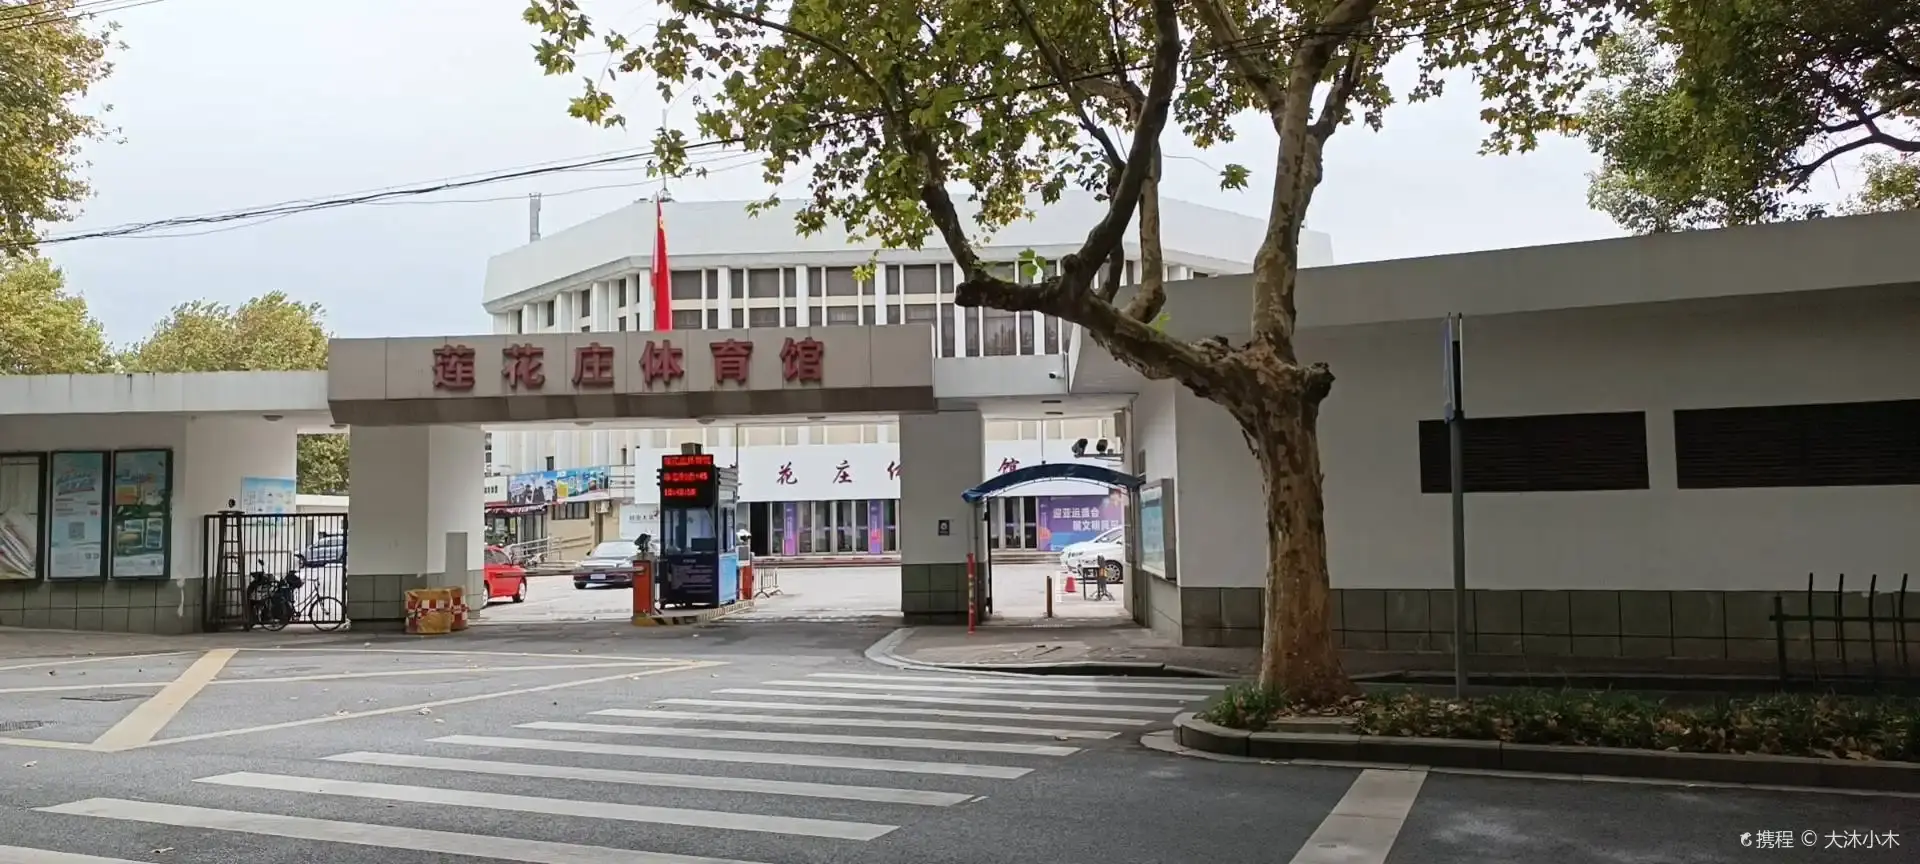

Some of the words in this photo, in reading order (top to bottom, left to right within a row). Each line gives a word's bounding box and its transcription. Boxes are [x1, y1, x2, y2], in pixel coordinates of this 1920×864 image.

[433, 337, 825, 389] 莲花庄体育馆
